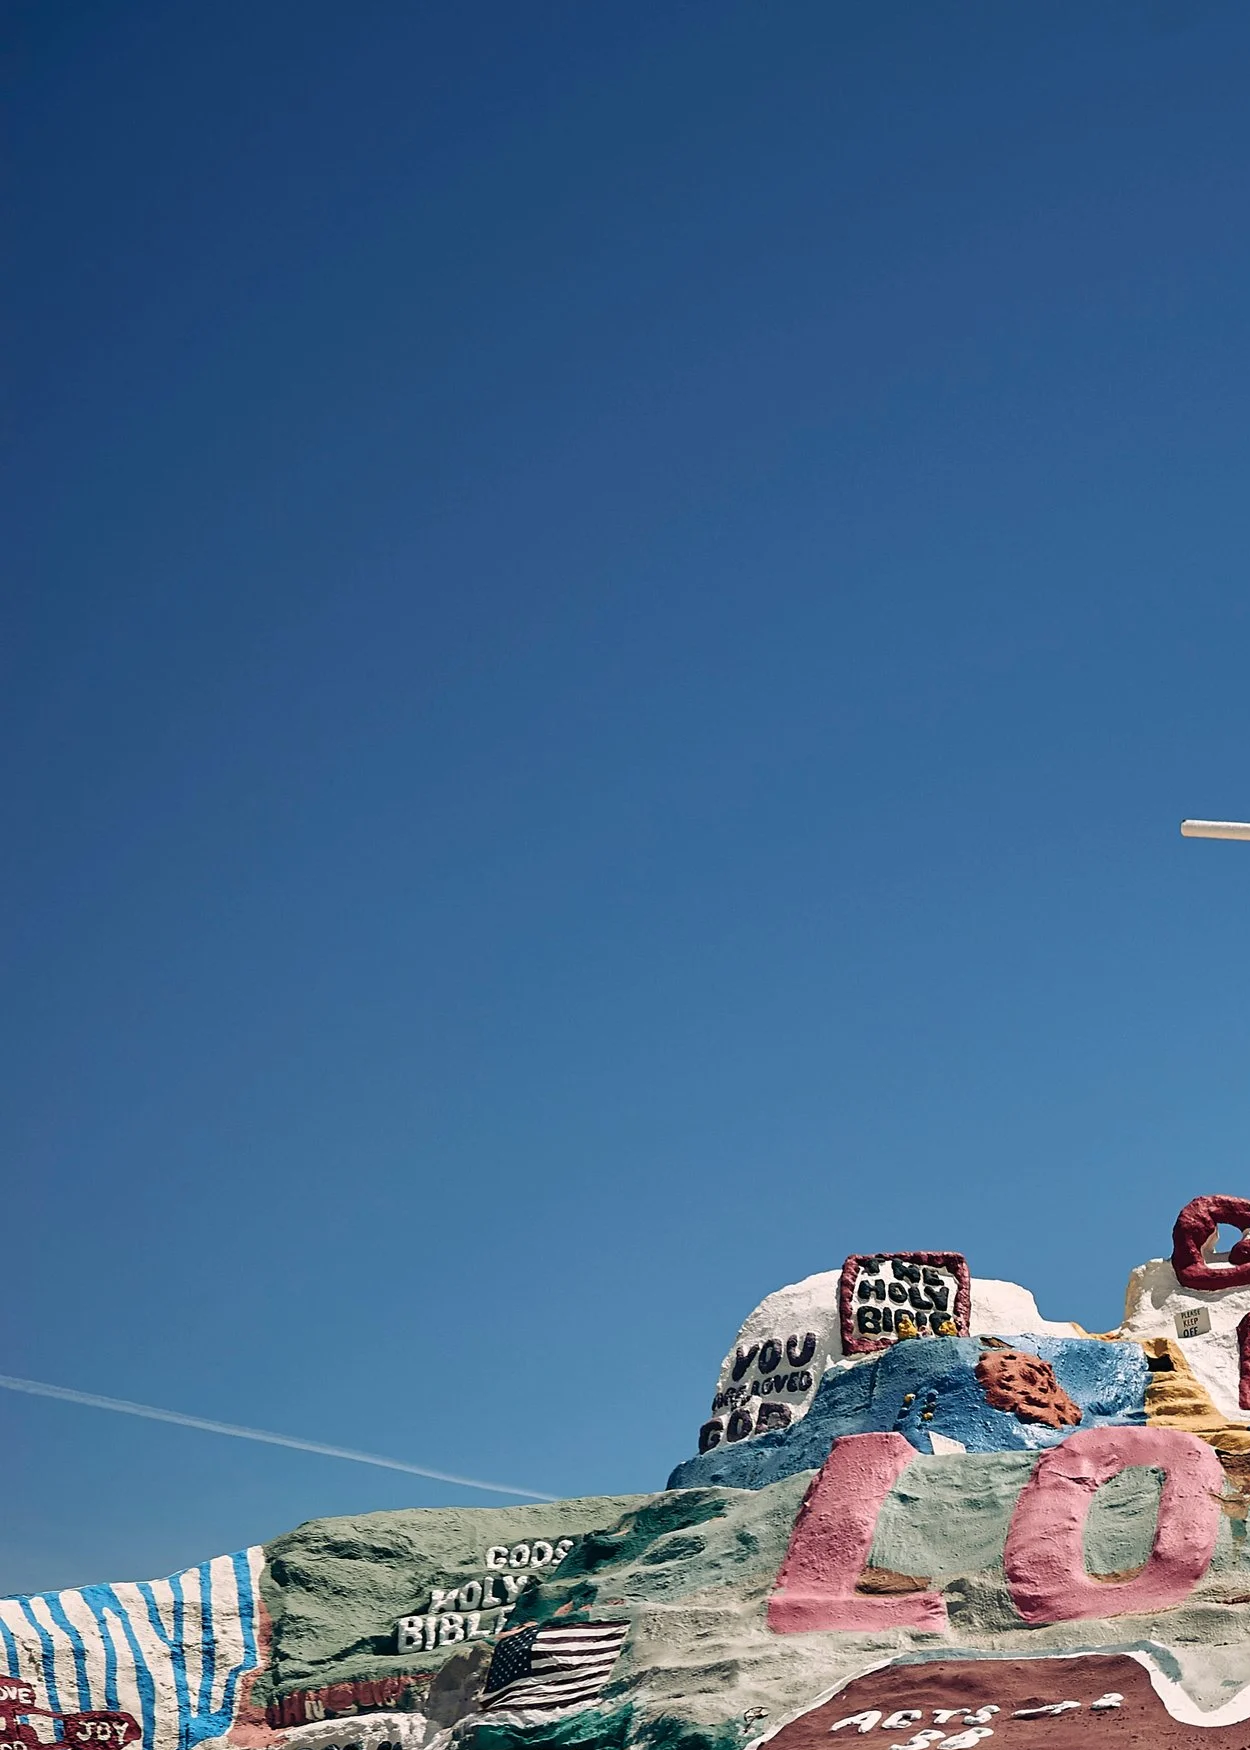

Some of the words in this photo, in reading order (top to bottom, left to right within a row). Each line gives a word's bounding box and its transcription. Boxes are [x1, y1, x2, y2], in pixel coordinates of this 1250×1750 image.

[863, 1258, 945, 1286] THE
[858, 1278, 950, 1311] HOLY
[1181, 1309, 1201, 1319] PLEASE
[1183, 1317, 1199, 1328] KEEP
[1183, 1326, 1198, 1338] OFF
[732, 1332, 817, 1382] YOU
[751, 1370, 813, 1398] LOVED
[699, 1402, 792, 1453] GOD
[487, 1540, 575, 1569] GODS
[429, 1575, 529, 1614] HOLY
[76, 1720, 129, 1745] JOY
[829, 1704, 1000, 1734] ACTS
